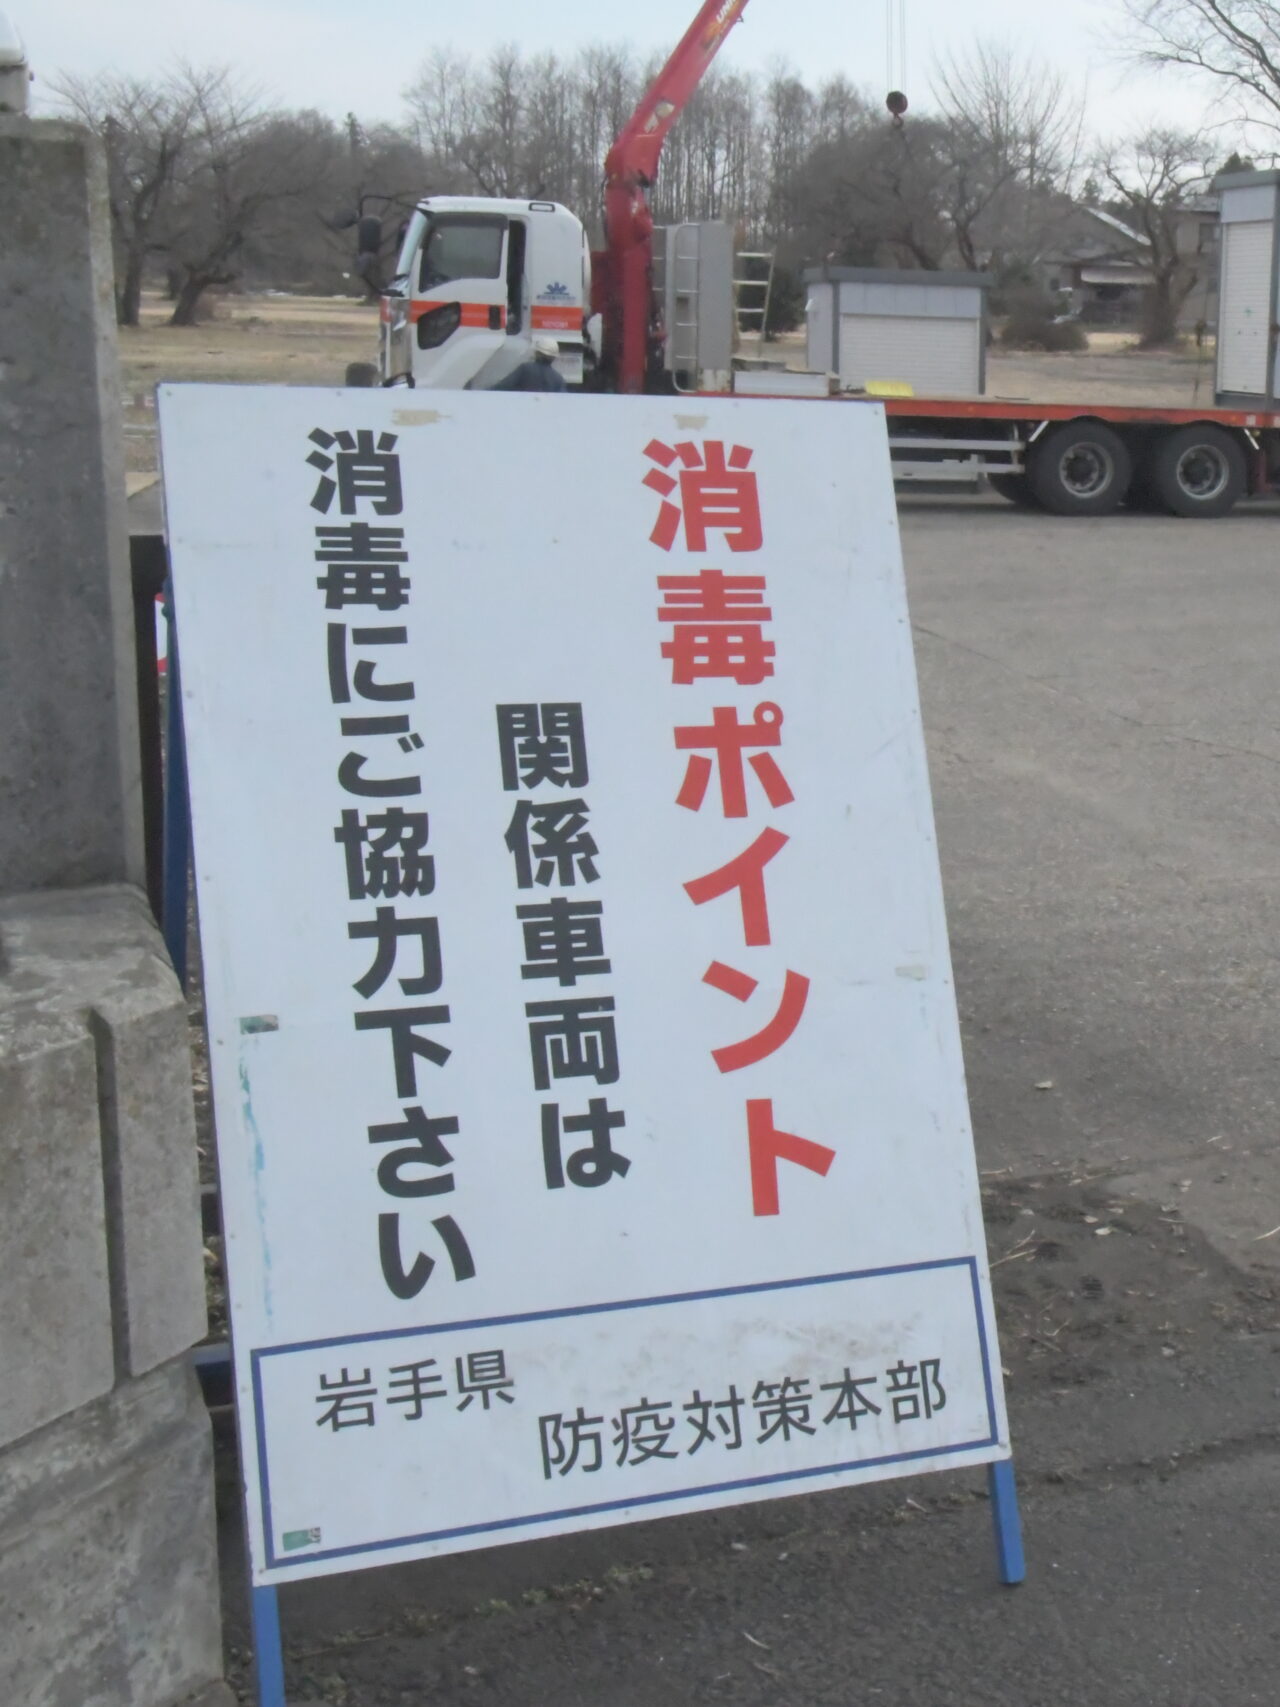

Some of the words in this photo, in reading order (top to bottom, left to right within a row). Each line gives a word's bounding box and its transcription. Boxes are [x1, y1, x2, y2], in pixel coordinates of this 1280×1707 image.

[304, 427, 477, 1300] 消毒にご協力下さい
[495, 702, 632, 1190] 関係車両は
[643, 439, 836, 1217] 消毒ポイント
[315, 1349, 515, 1433] 岩手県
[538, 1357, 948, 1481] 防疫対策本部
